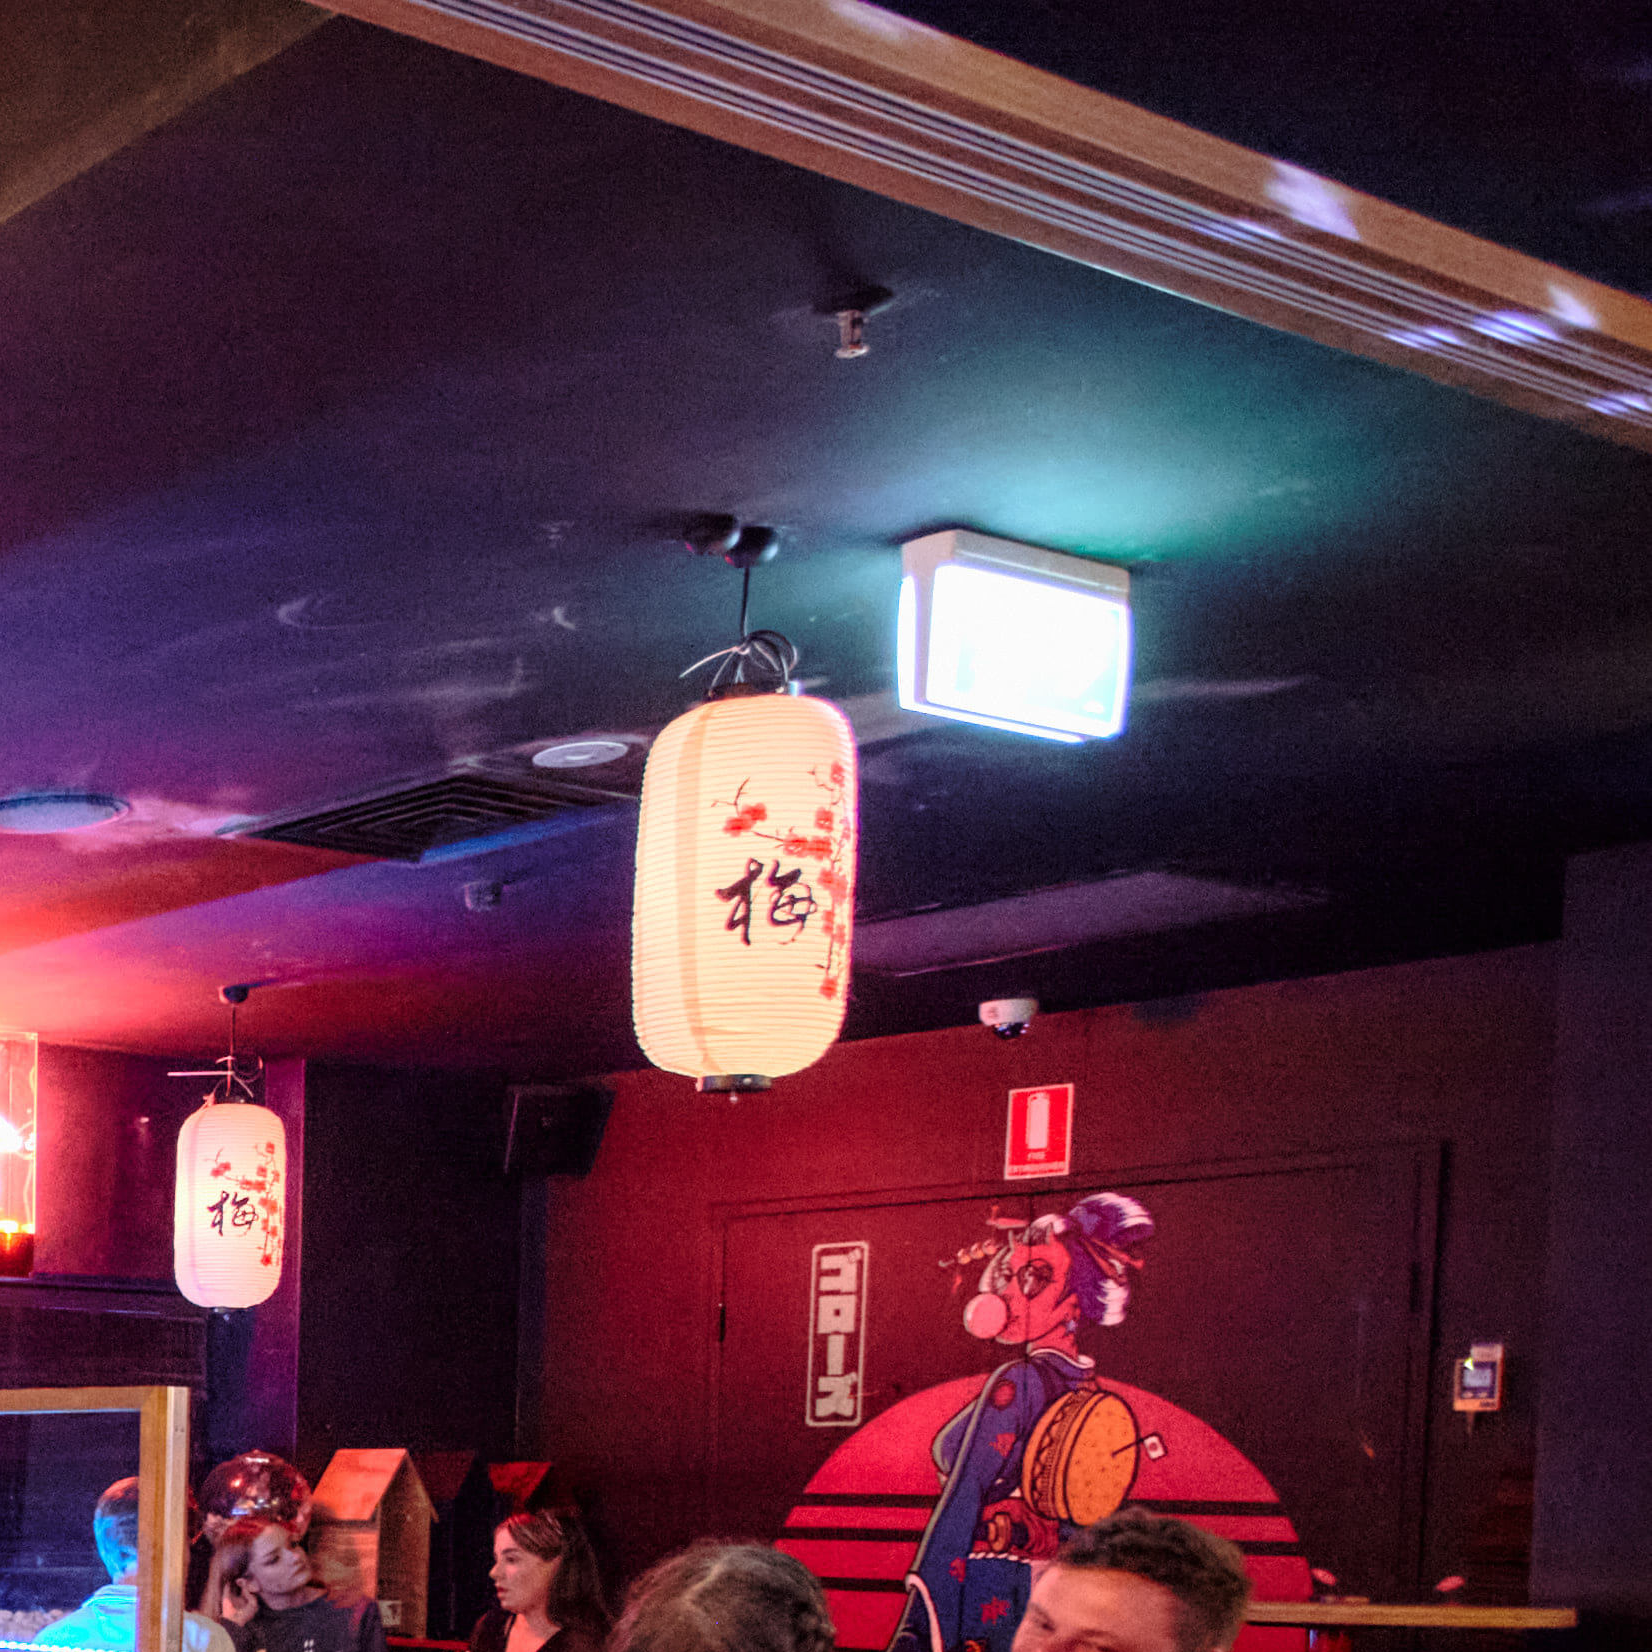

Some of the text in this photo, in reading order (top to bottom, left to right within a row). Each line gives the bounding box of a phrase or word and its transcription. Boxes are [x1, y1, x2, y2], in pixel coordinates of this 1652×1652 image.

[714, 857, 818, 946] 梅
[207, 1190, 259, 1237] 梅
[816, 1249, 862, 1418] ゴローズ
